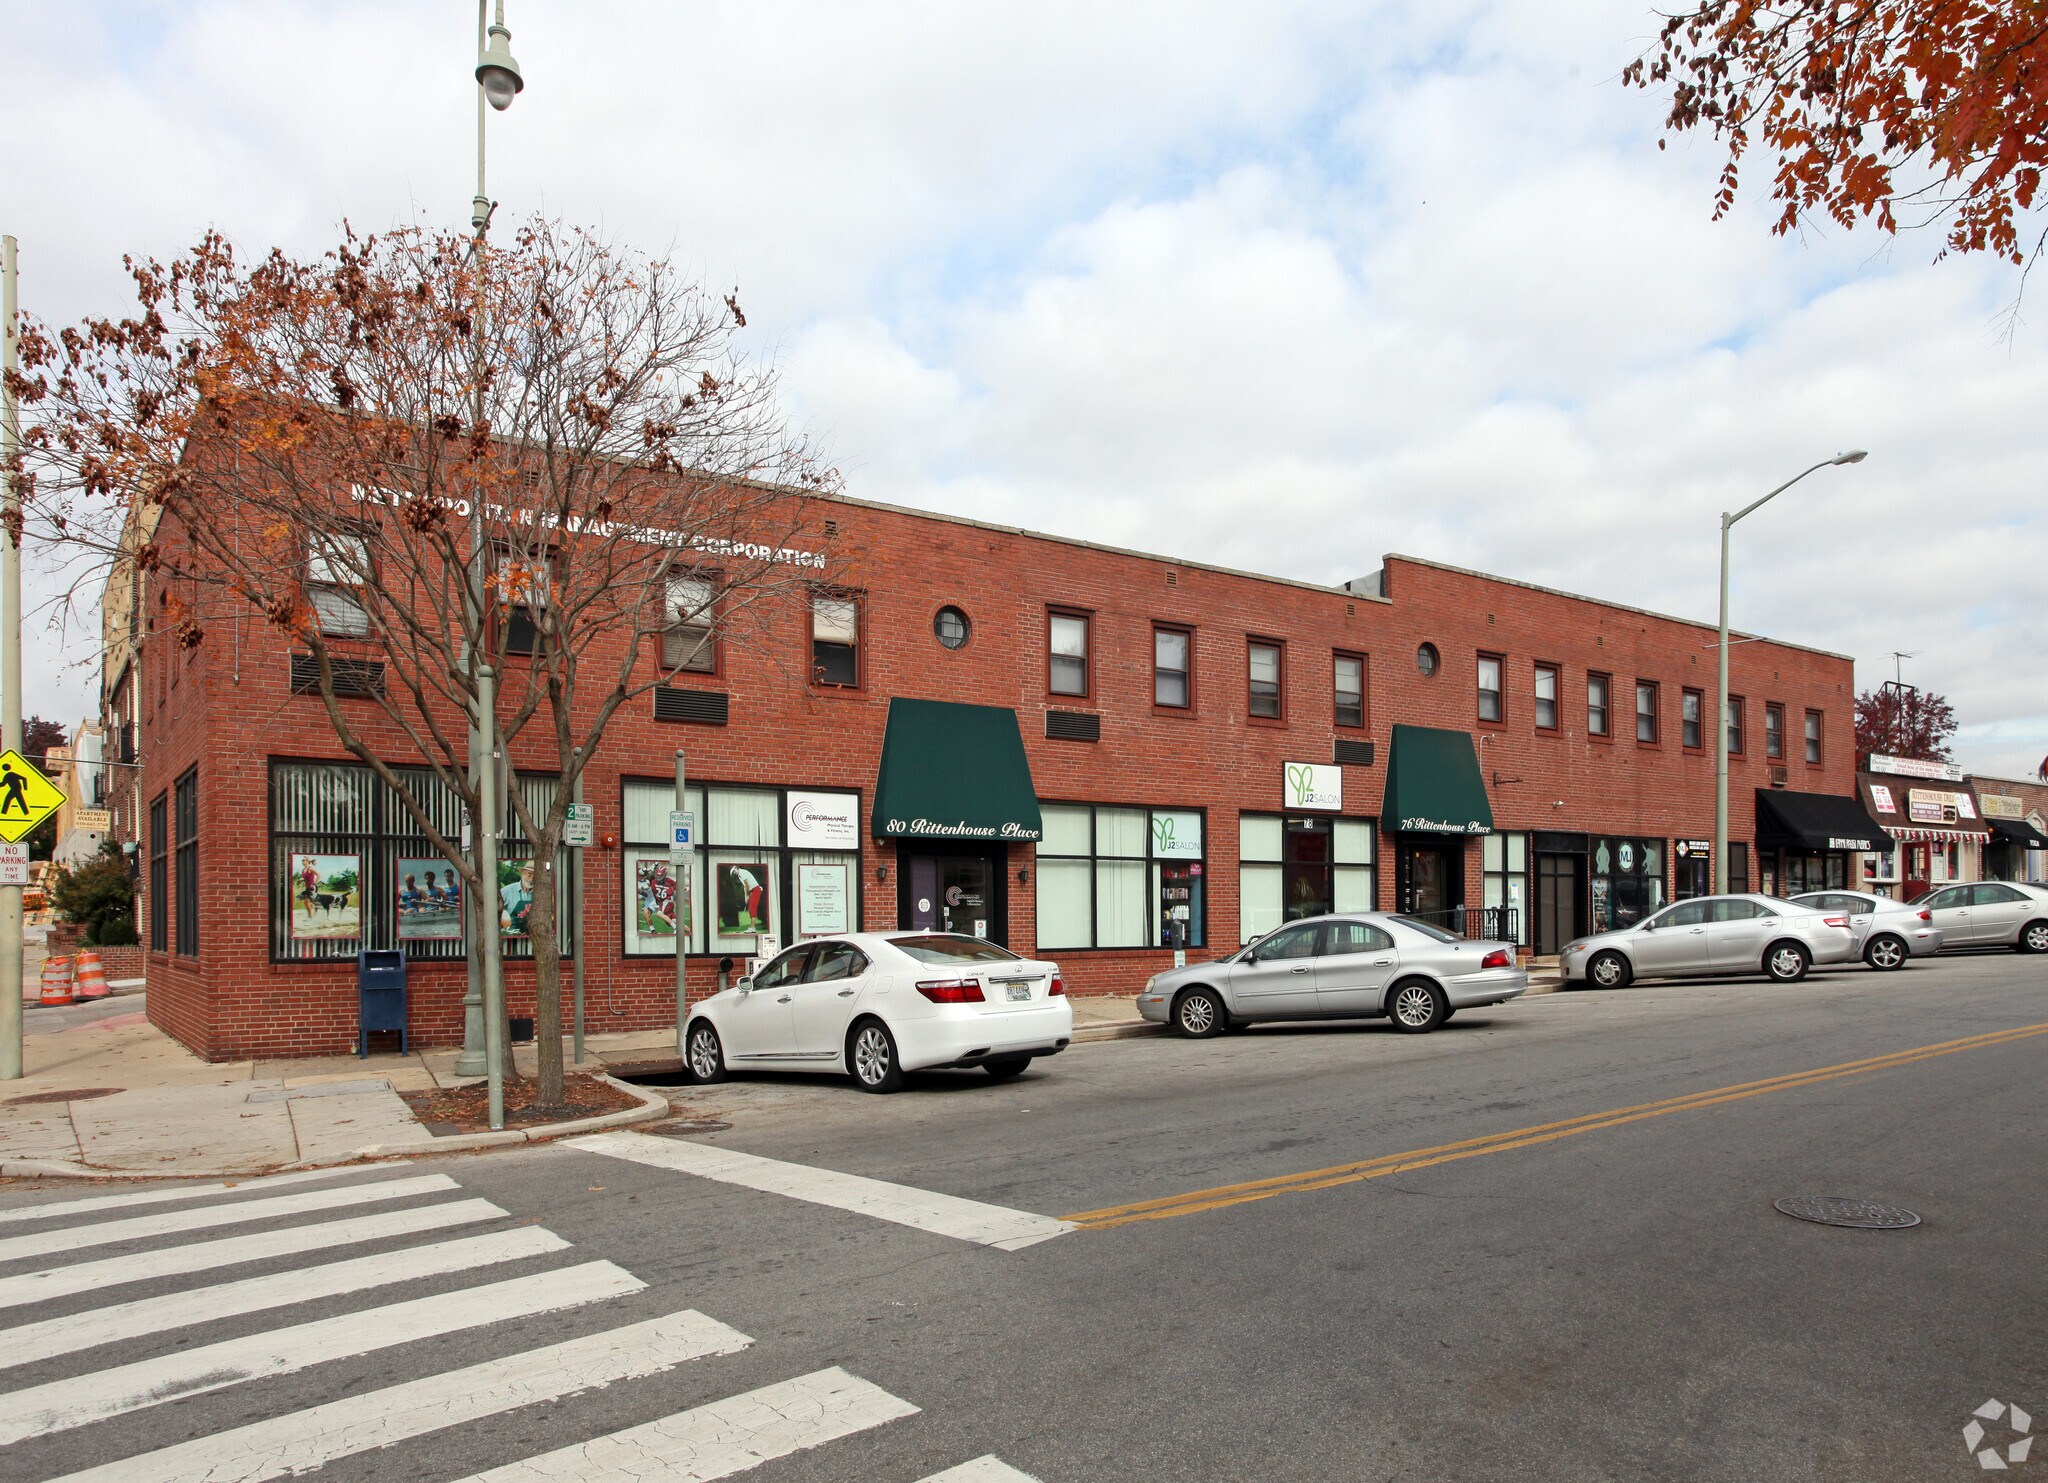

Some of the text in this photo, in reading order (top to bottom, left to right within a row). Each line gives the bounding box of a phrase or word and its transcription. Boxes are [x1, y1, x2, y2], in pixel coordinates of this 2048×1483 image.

[693, 535, 826, 569] CORPORATION
[1912, 790, 1942, 802] RITTENHOUSE
[568, 808, 574, 818] 2
[886, 818, 1040, 838] 80 Rittenhouse Place
[1401, 818, 1490, 833] 76 Rittenhouse Place
[656, 888, 667, 899] 26
